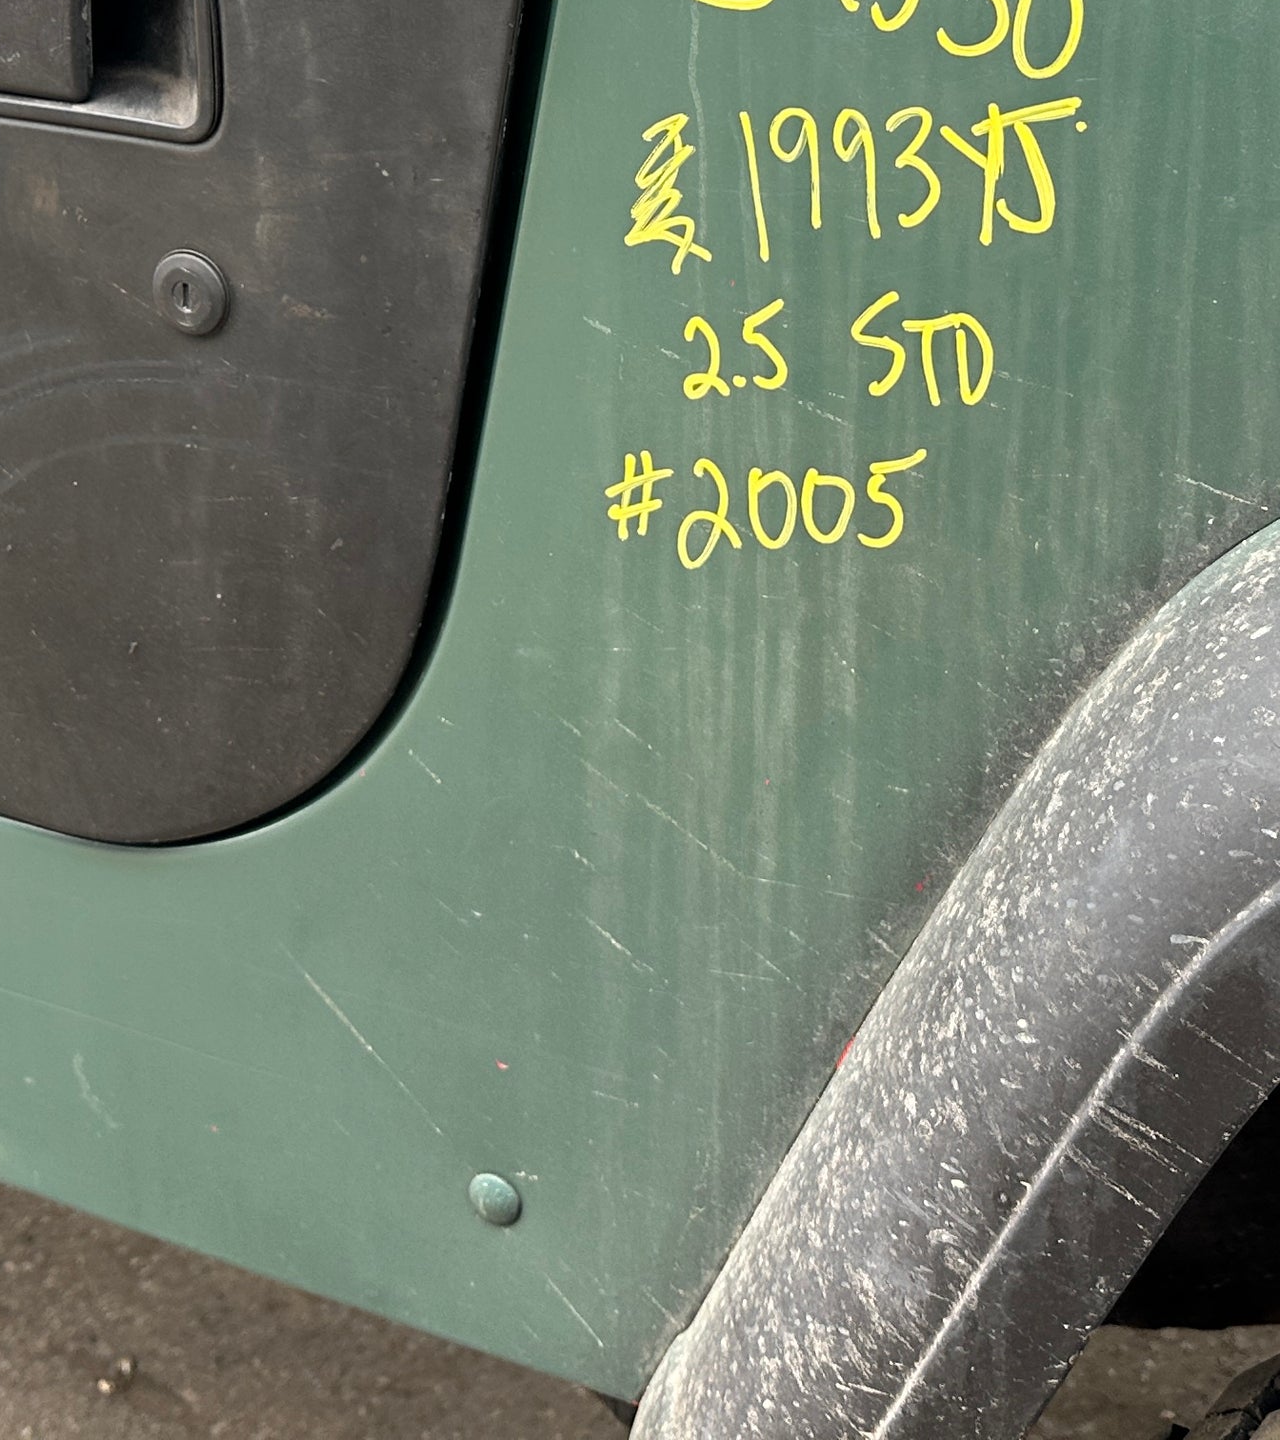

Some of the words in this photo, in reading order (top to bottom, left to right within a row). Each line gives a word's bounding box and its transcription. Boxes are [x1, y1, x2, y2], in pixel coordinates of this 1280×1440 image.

[682, 299, 790, 400] 2.5
[851, 291, 995, 406] STD
[605, 449, 927, 571] #2005
